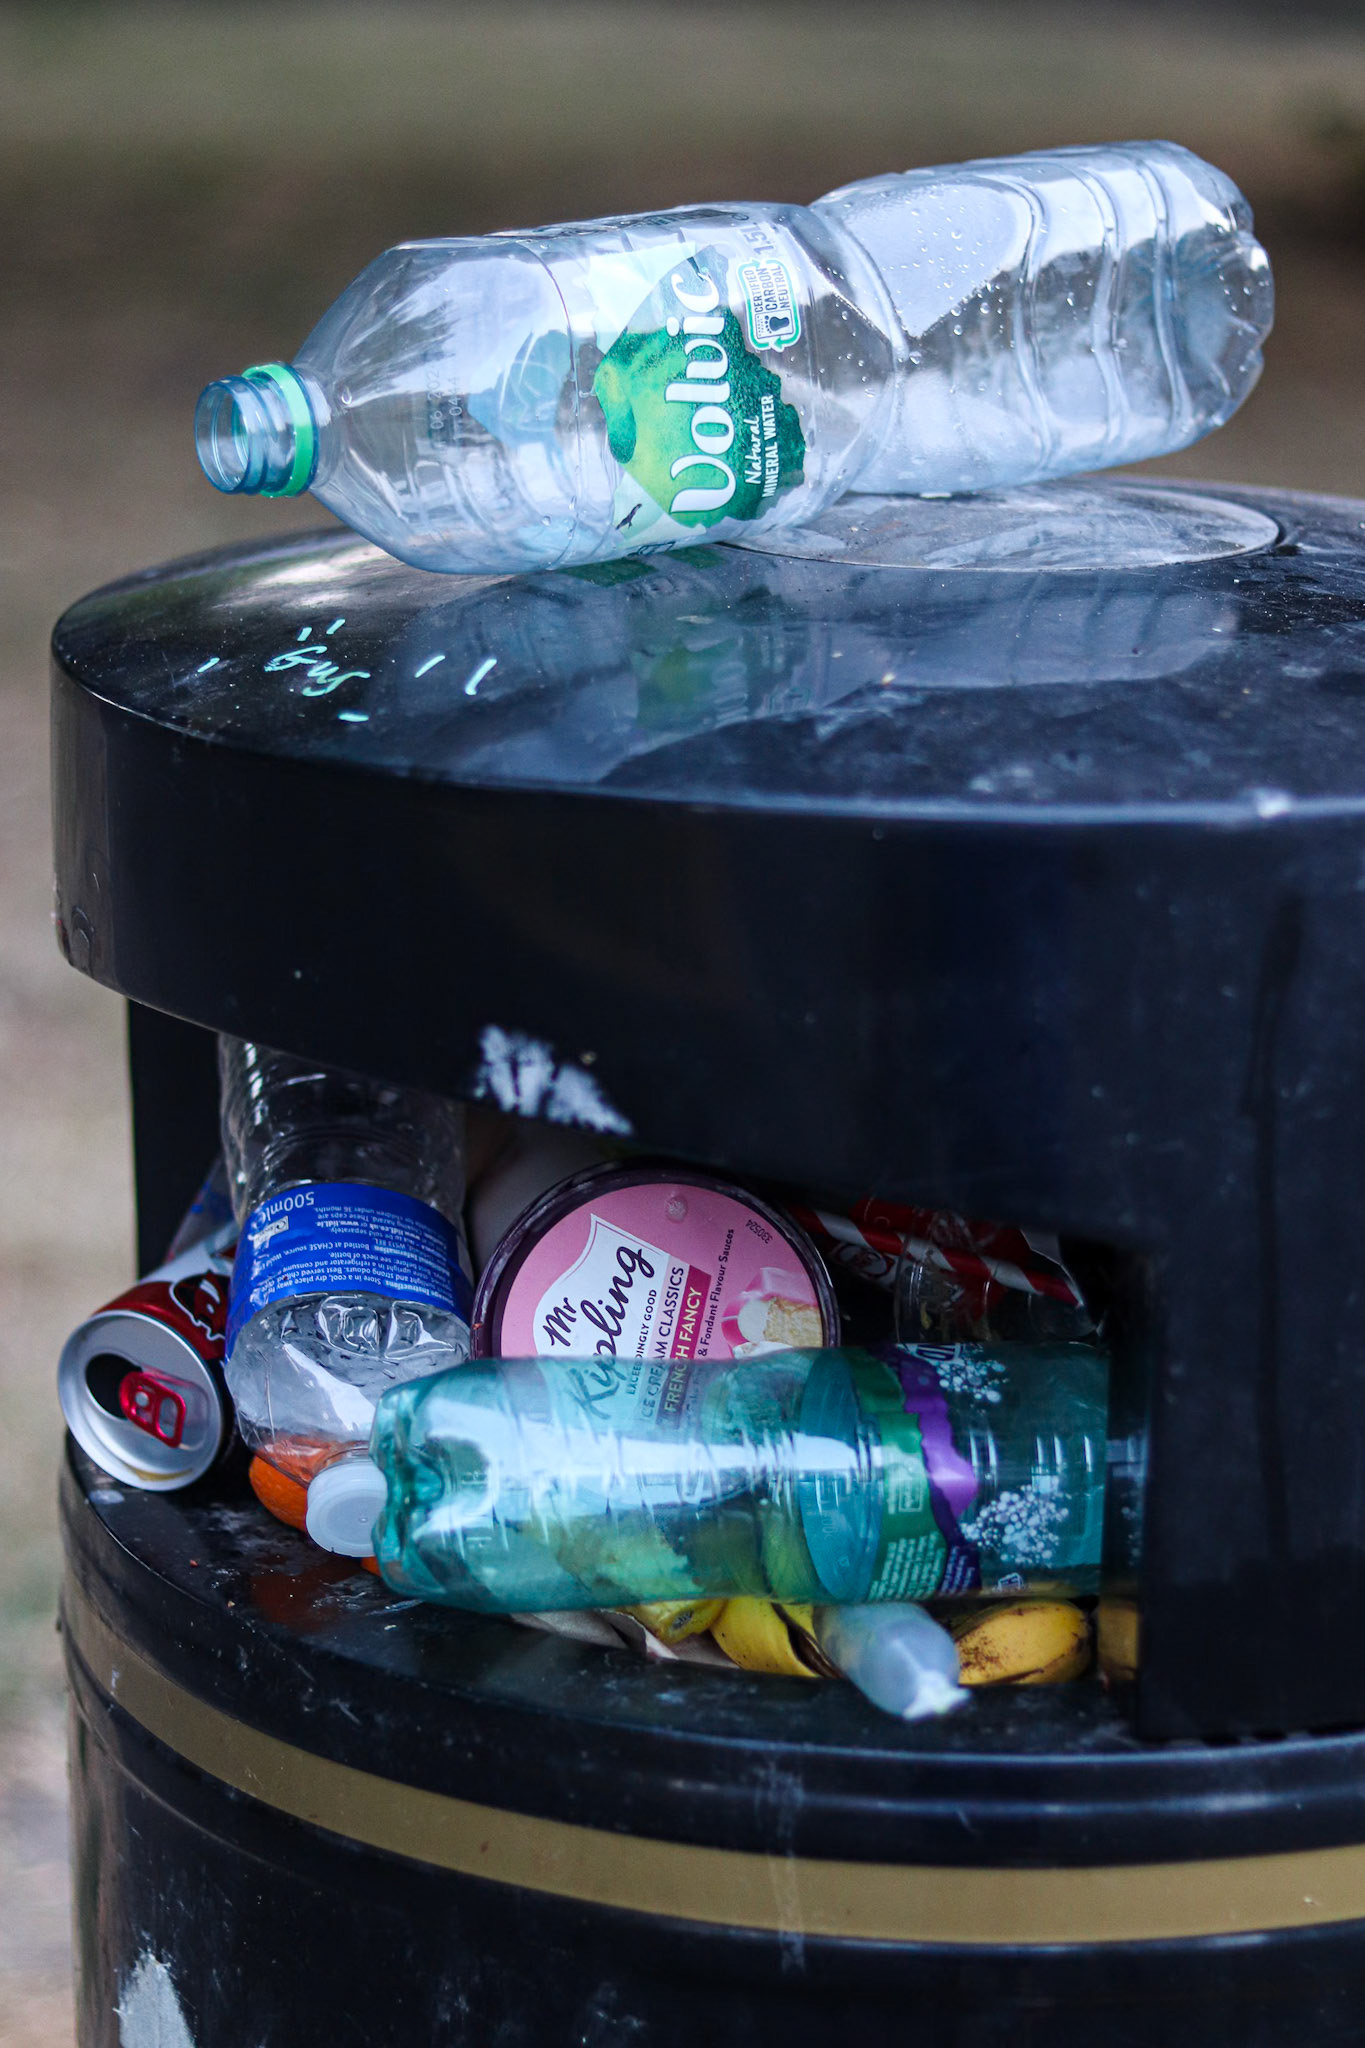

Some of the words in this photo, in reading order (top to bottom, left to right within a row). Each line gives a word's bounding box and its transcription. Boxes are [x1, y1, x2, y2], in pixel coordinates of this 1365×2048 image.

[744, 269, 764, 313] CERTIFIED
[756, 266, 778, 311] CARBON
[771, 264, 790, 309] NEUTRAL
[761, 394, 775, 442] WATER
[744, 415, 760, 485] Natural
[762, 443, 780, 498] MINERAL
[265, 1192, 314, 1222] 500ml
[349, 1214, 369, 1223] These
[745, 1219, 773, 1244] 330524
[310, 1242, 333, 1251] CHASE
[344, 1242, 369, 1251] Bottled
[718, 1228, 735, 1263] Sauces
[330, 1258, 370, 1266] refrigerator
[362, 1253, 378, 1261] neck
[294, 1275, 313, 1284] place
[301, 1268, 325, 1276] served
[315, 1274, 327, 1282] dry
[329, 1274, 346, 1282] cool,
[372, 1268, 394, 1279] strong
[387, 1265, 411, 1274] upright
[396, 1274, 408, 1282] and
[277, 1280, 293, 1289] away
[363, 1276, 381, 1285] Store
[386, 1280, 430, 1296] Instructions
[710, 1264, 727, 1302] Flavour
[644, 1289, 657, 1321] GOOD
[659, 1266, 684, 1337] CLASSICS
[543, 1297, 577, 1347] Mr
[700, 1304, 718, 1346] Fondant
[566, 1246, 655, 1420] Kipling
[664, 1346, 690, 1413] FRENCH
[679, 1286, 702, 1345] FANCY
[697, 1346, 707, 1357] &
